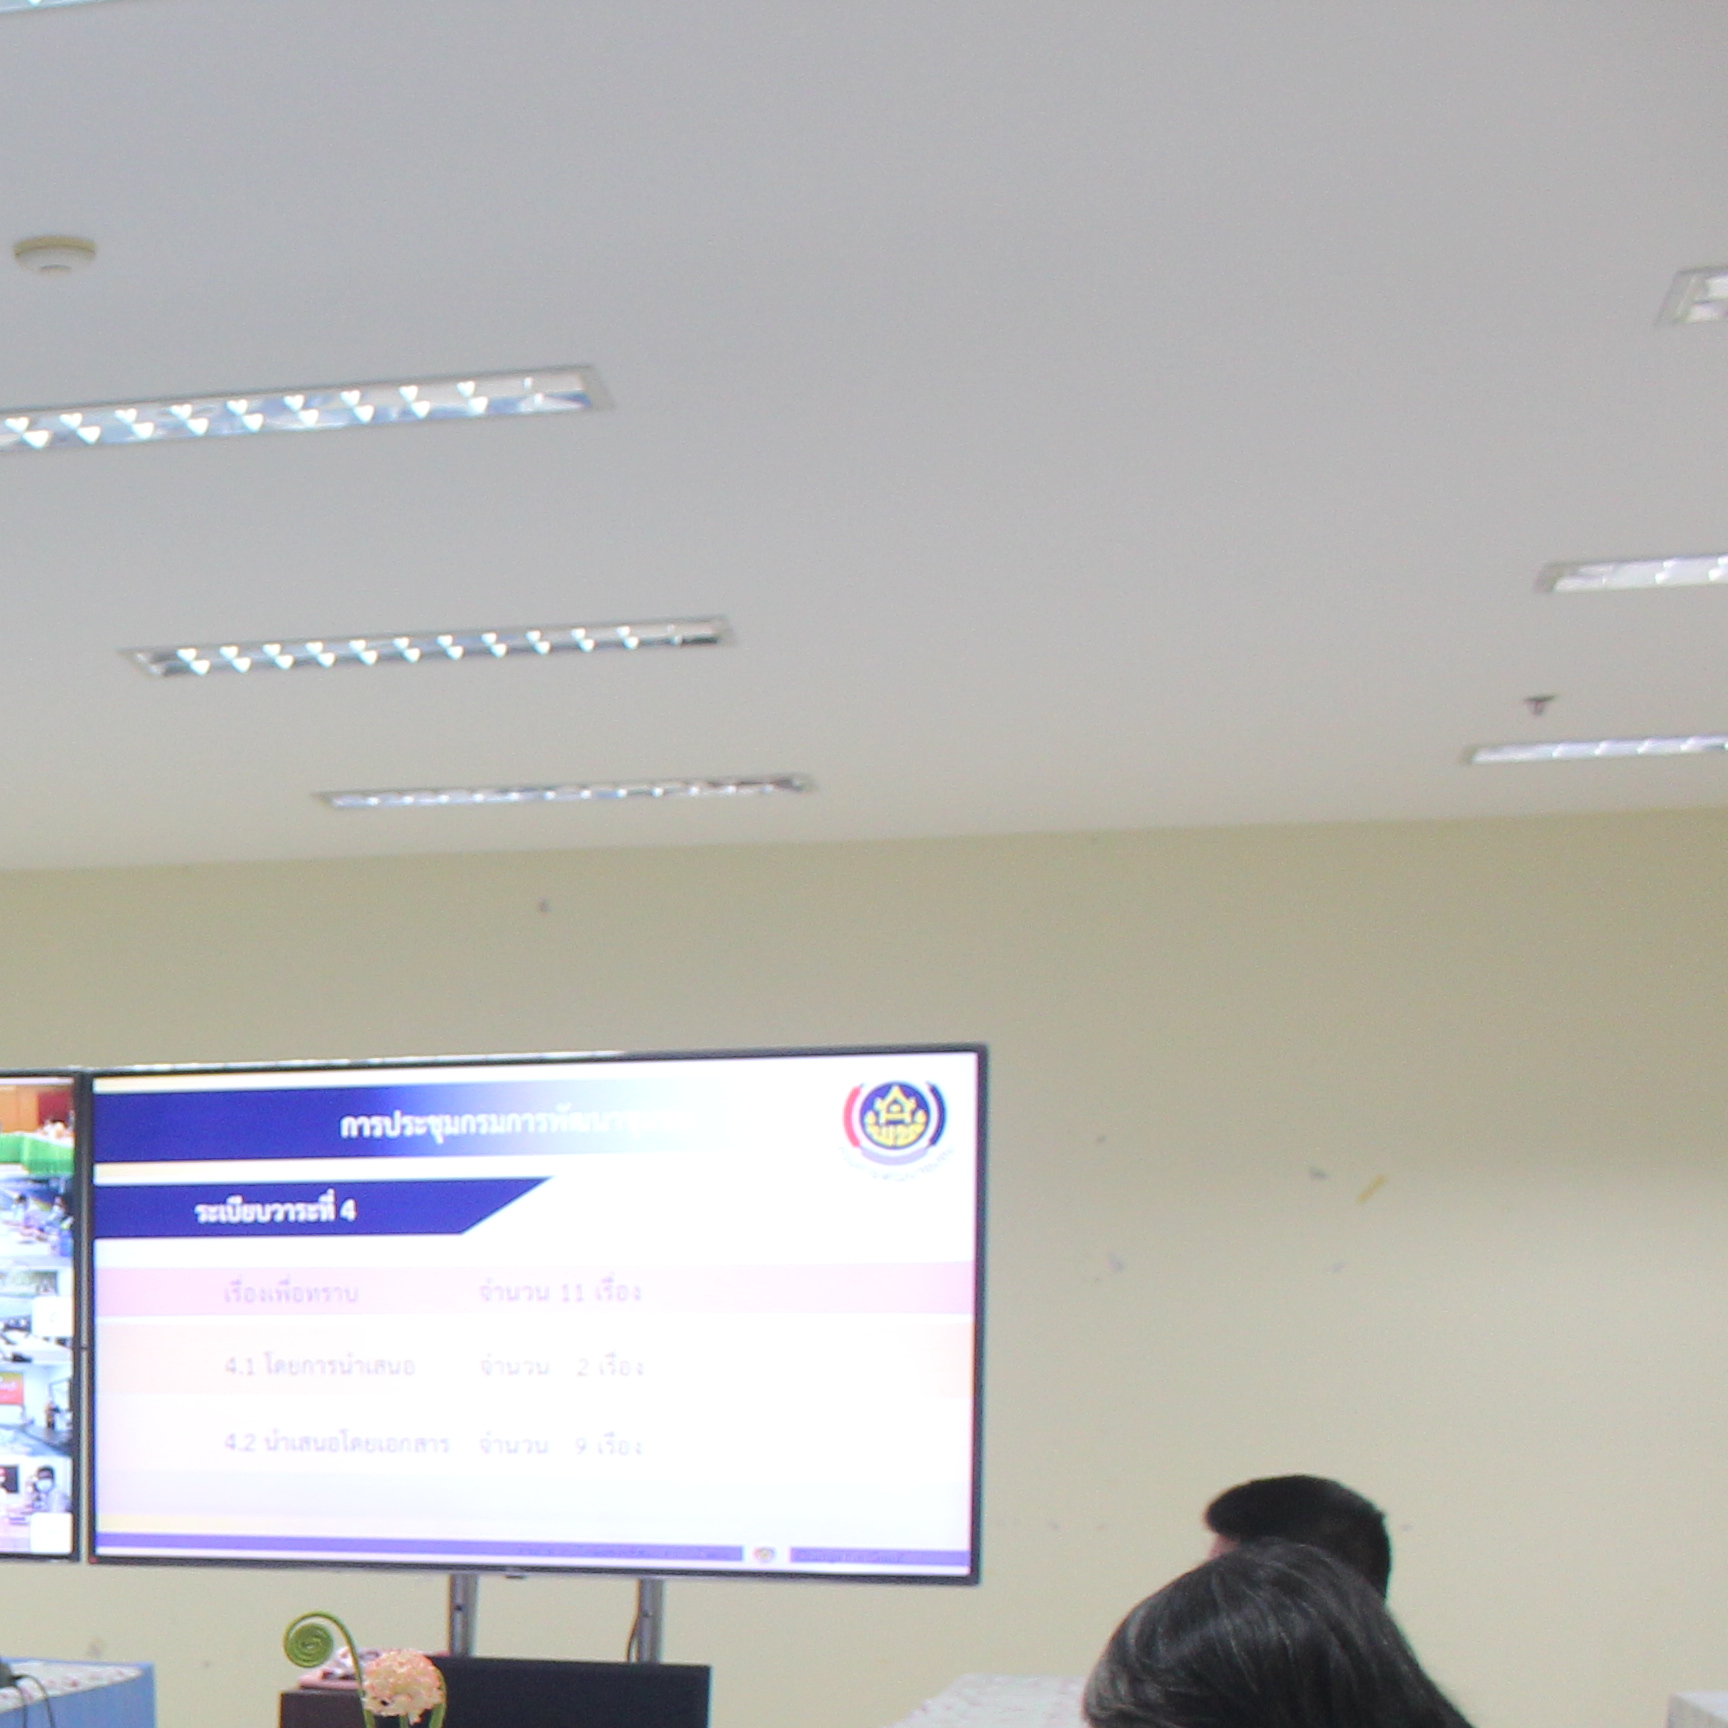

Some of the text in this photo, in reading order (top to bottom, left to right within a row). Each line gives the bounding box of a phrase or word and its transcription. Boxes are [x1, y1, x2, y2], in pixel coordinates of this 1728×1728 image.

[193, 1188, 358, 1224] ระเบียบวาระที่ 4
[223, 1271, 643, 1304] เรื่องเพื่อทราบ จำนวน 11 เรื่อง
[223, 1349, 646, 1377] 4.1 โดยการนำเสนอ จำนวน 2 เรื่อง
[223, 1427, 643, 1456] 4.2 นำเสนอโดยเอกสาร จำนวน 9 เรื่อง
